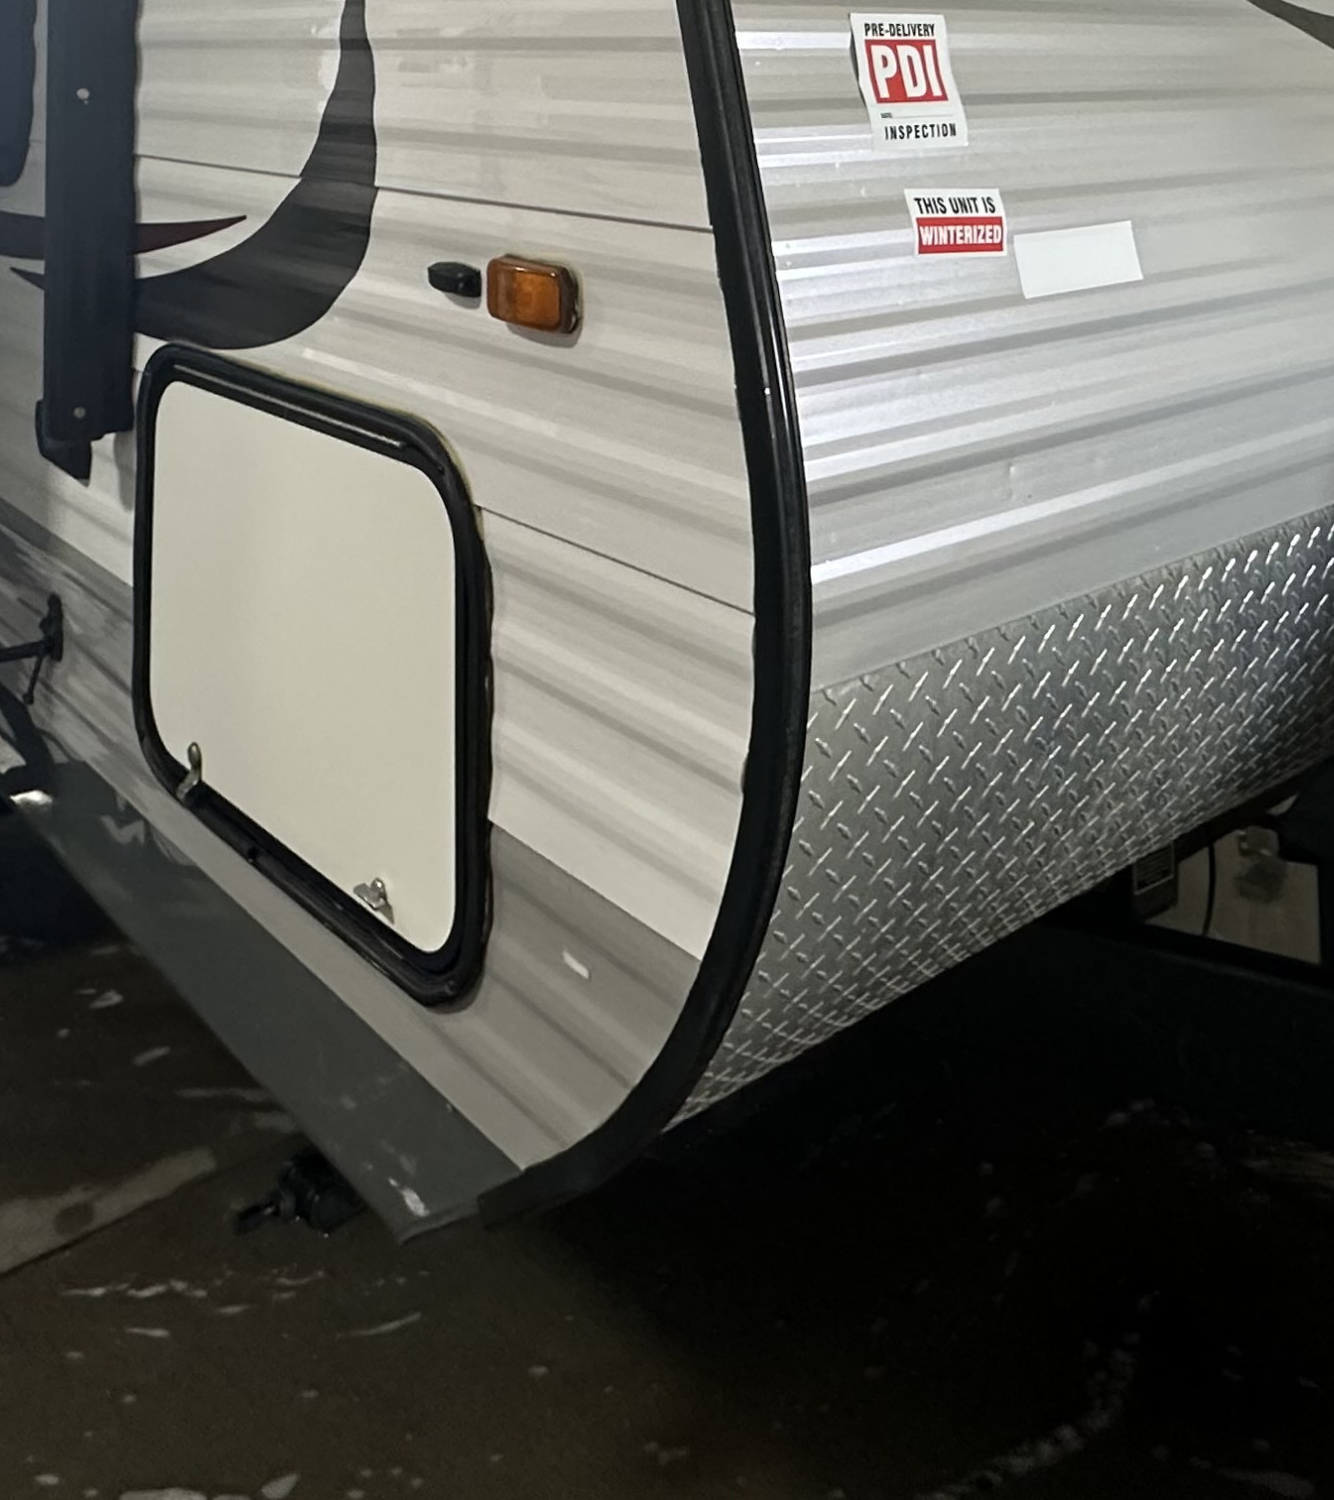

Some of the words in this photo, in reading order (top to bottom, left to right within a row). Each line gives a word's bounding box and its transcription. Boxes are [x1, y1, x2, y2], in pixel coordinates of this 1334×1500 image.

[864, 23, 935, 37] PRE-DELIVERY
[870, 44, 943, 98] PDI
[884, 123, 957, 140] INSPECTION
[914, 197, 947, 214] THIS
[948, 197, 979, 214] UNIT
[981, 197, 996, 213] IS
[919, 225, 1002, 246] WINTERIZED
